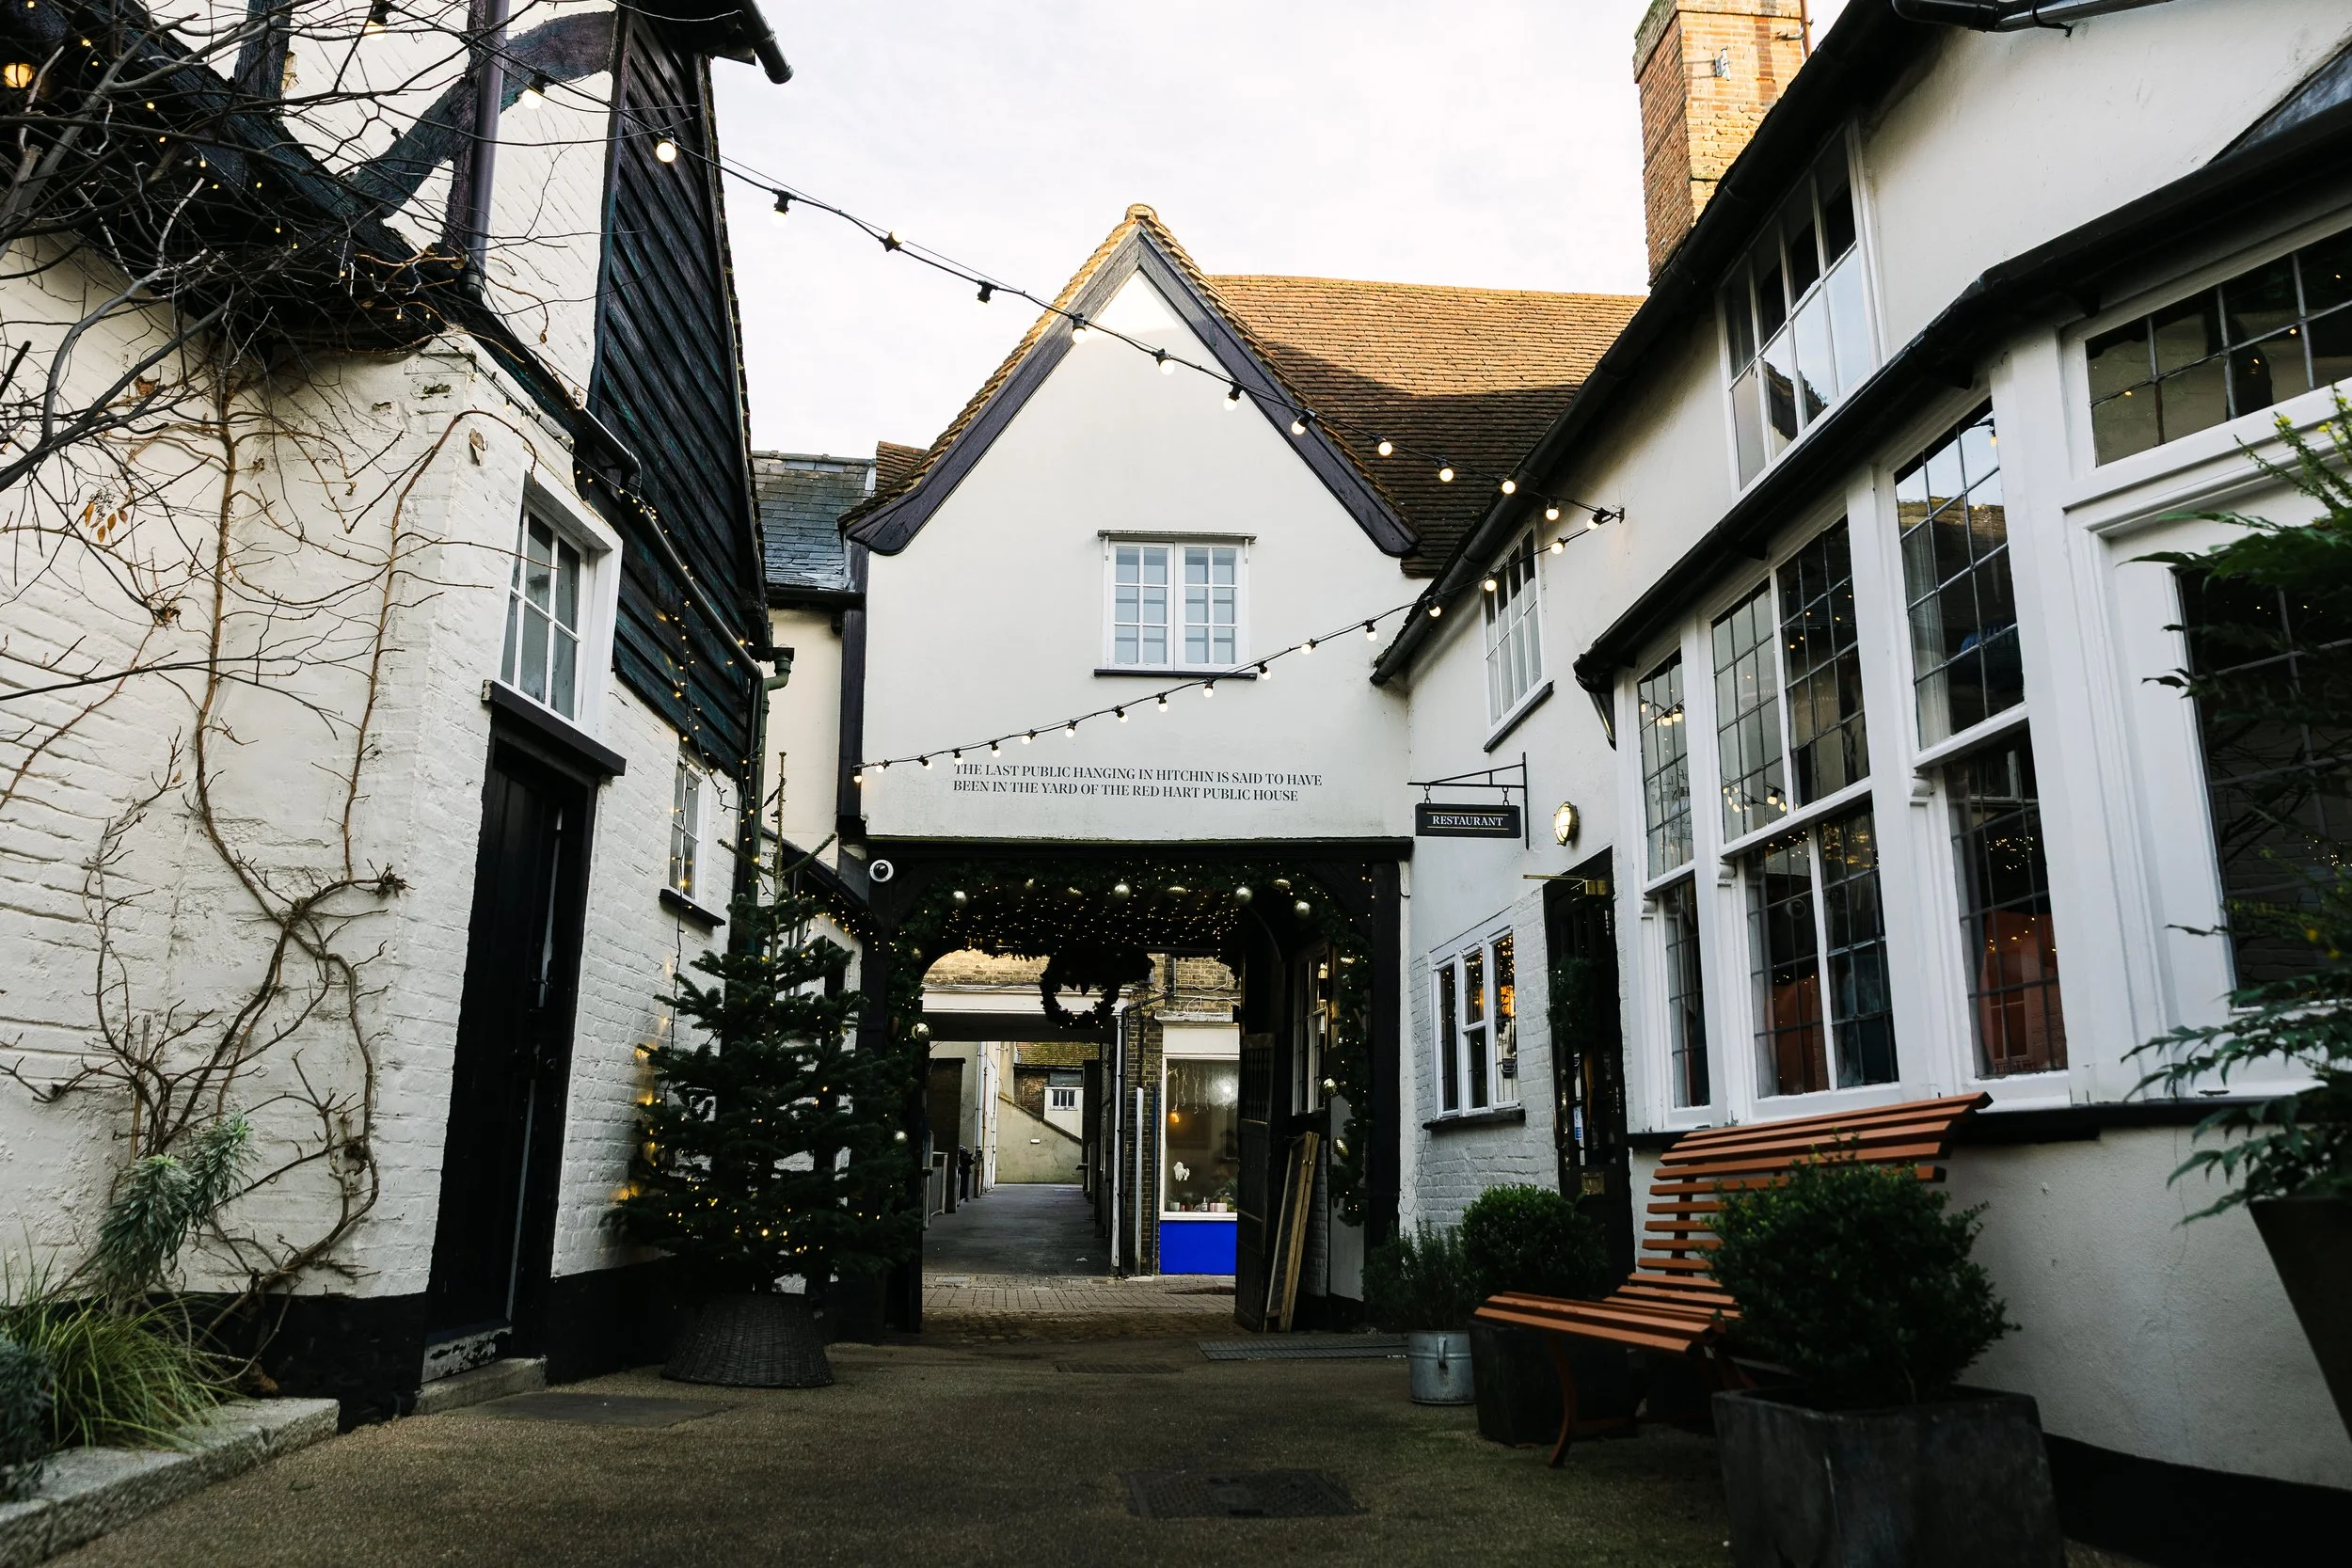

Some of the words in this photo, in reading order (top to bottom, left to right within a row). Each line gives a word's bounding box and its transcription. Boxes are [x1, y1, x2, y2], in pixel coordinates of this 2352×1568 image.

[954, 764, 982, 775] THE
[986, 765, 1020, 777] LAST
[1023, 766, 1071, 778] PUBLIC
[1073, 768, 1136, 780] HANGING
[1139, 769, 1153, 781] IN
[1156, 769, 1215, 783] HITCHIN
[1217, 771, 1230, 784] IS
[1232, 772, 1263, 784] SAID
[1265, 773, 1284, 785] TO
[1287, 774, 1323, 786] HAVE
[953, 780, 990, 792] BEEN
[993, 782, 1008, 793] IN
[1009, 782, 1039, 794] THE
[1041, 783, 1078, 795] YARD
[1080, 784, 1099, 795] OF
[1101, 784, 1130, 796] THE
[1133, 785, 1160, 797] RED
[1163, 786, 1200, 799] HART
[1203, 788, 1251, 800] PUBLIC
[1253, 789, 1298, 801] HOUSE
[1432, 816, 1503, 827] RESTAURANT
